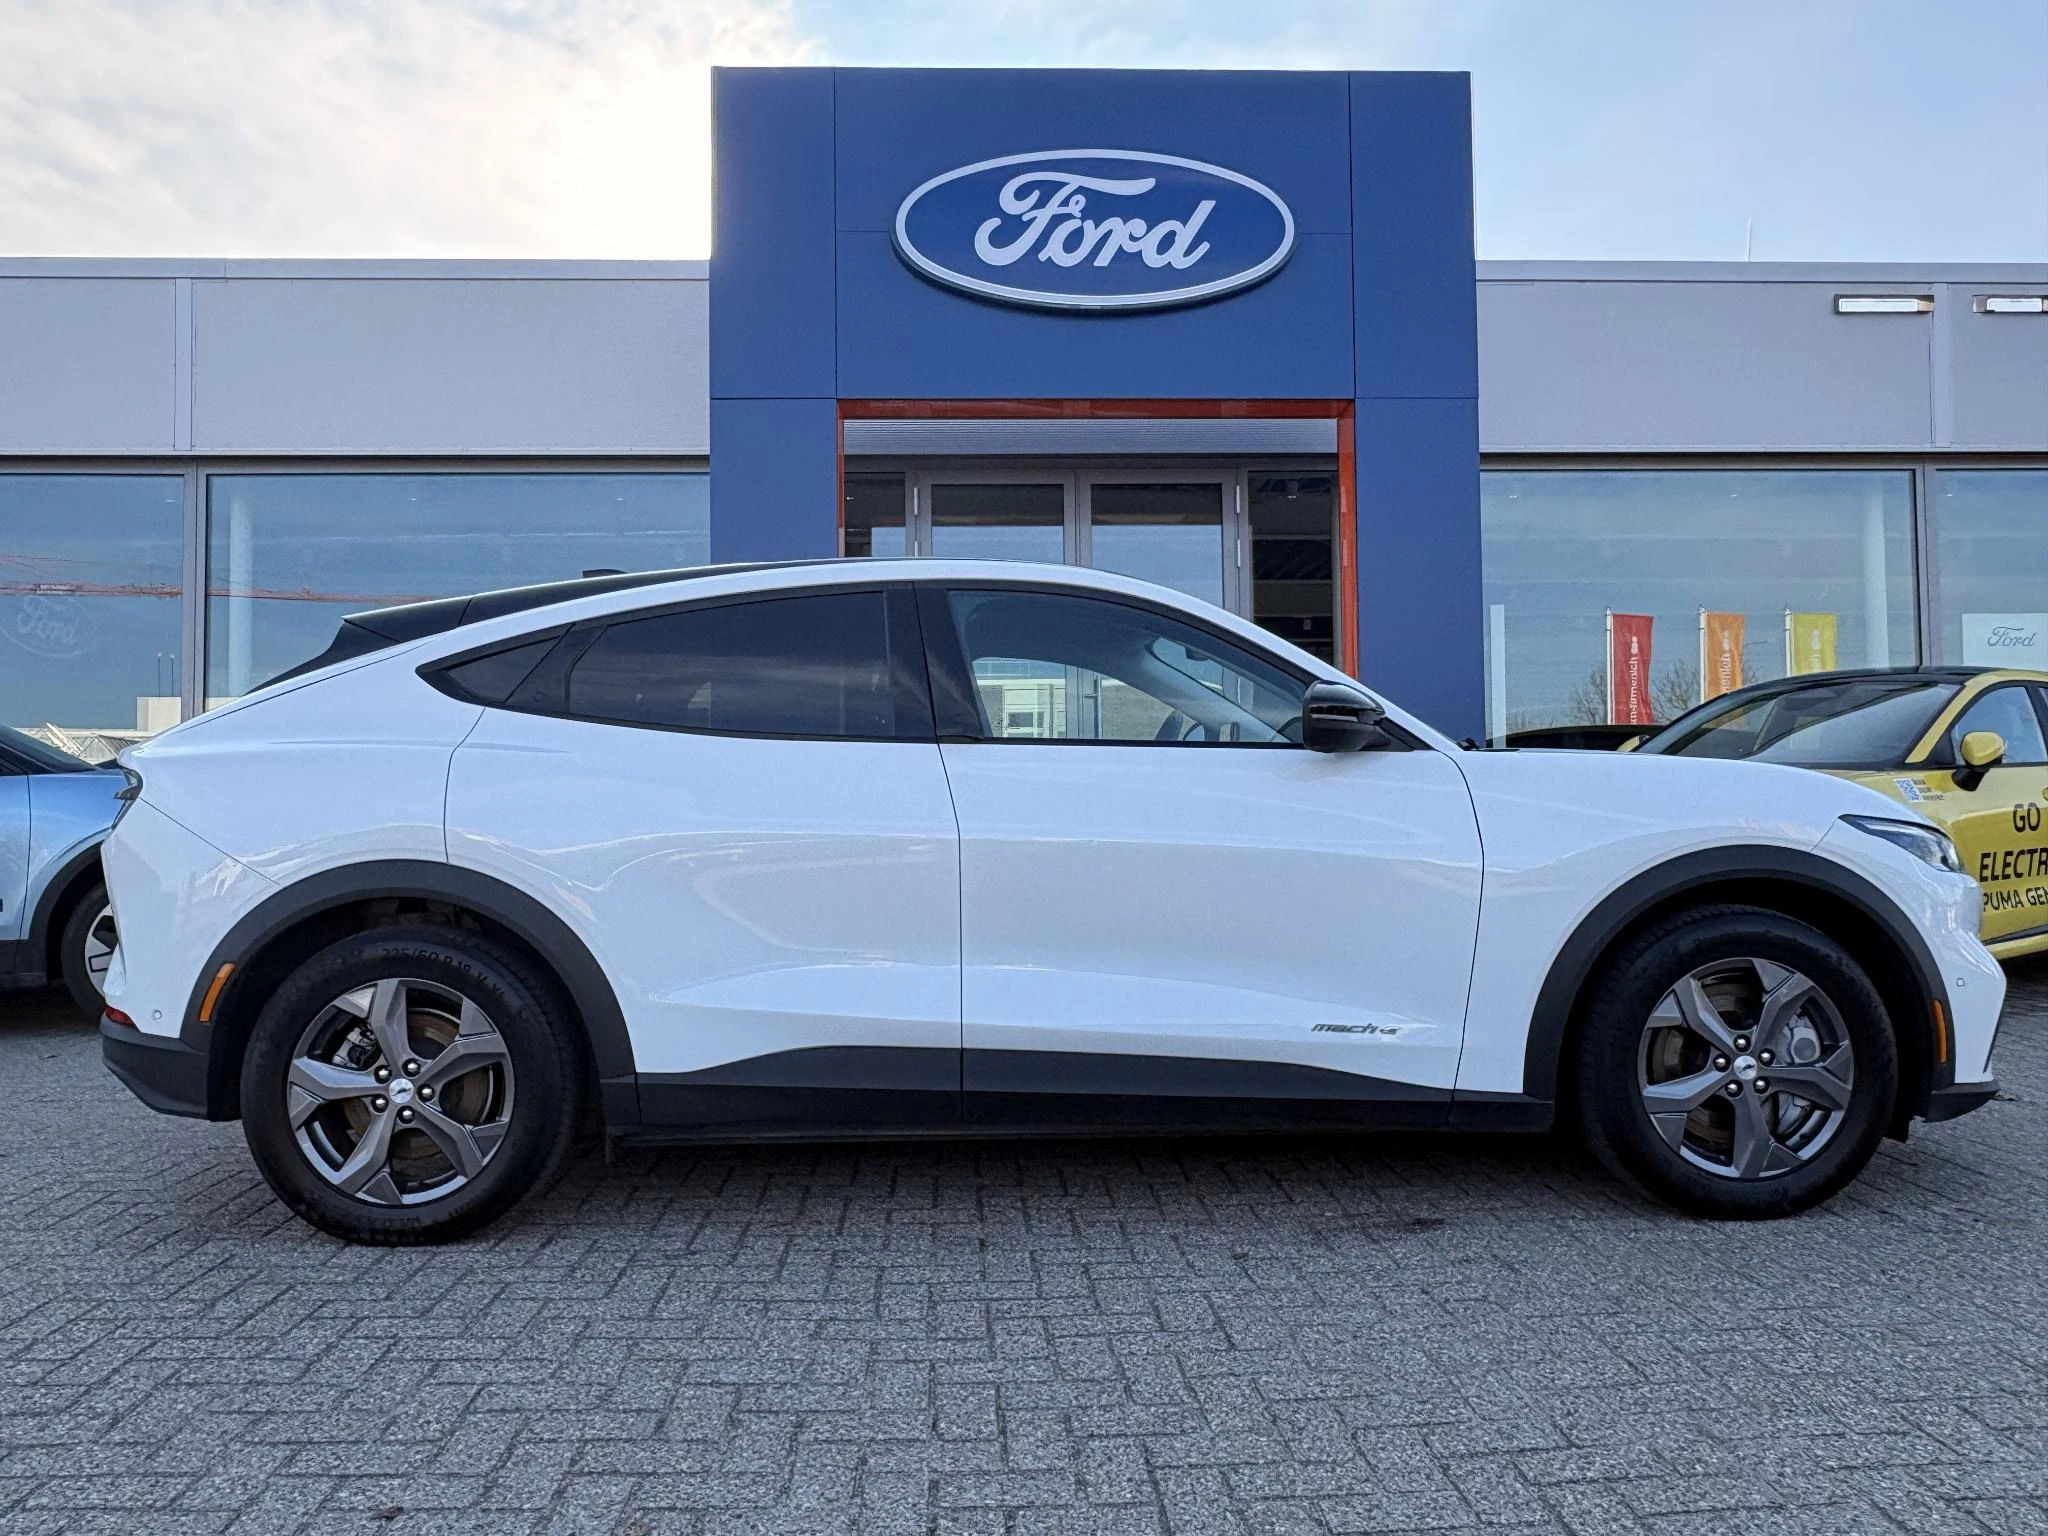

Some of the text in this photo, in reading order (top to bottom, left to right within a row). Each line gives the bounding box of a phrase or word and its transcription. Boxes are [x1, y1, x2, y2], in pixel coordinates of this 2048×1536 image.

[974, 171, 1216, 269] Ford
[1987, 626, 2037, 647] Ford
[2012, 802, 2041, 832] GO
[1983, 888, 2024, 912] PUMA
